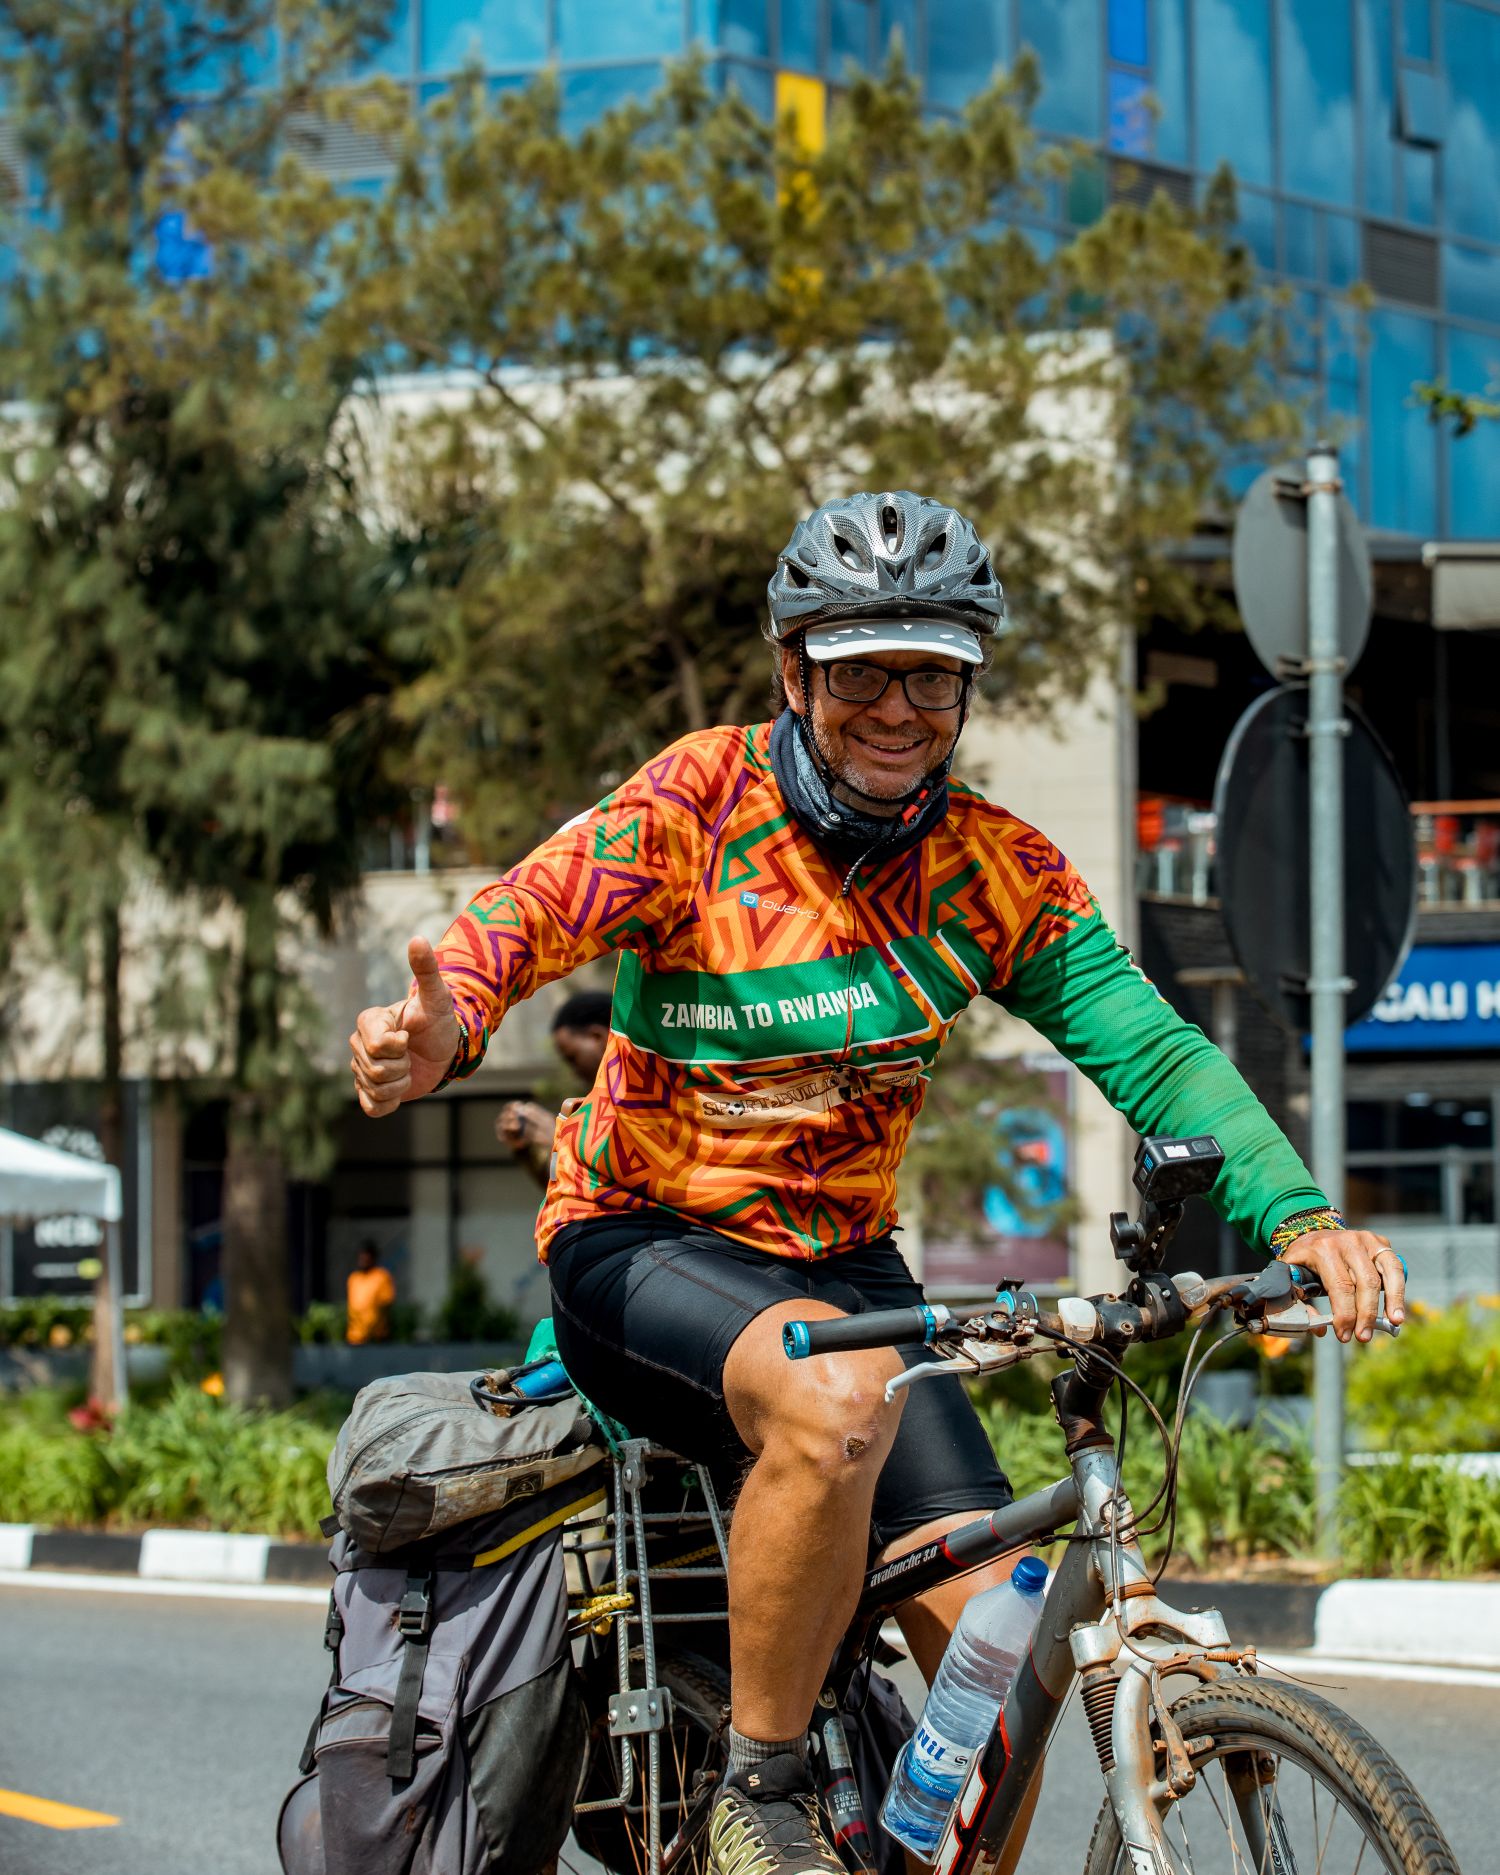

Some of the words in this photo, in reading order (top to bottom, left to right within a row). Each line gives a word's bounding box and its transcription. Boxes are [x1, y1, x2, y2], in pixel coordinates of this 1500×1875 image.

[661, 1003, 738, 1031] ZAMBIA
[741, 1002, 774, 1029] TO
[778, 981, 880, 1025] RWANDA
[1367, 980, 1468, 1023] GALI
[869, 1552, 922, 1588] avalanche
[923, 1545, 938, 1562] 3.0
[917, 1727, 946, 1761] Nil
